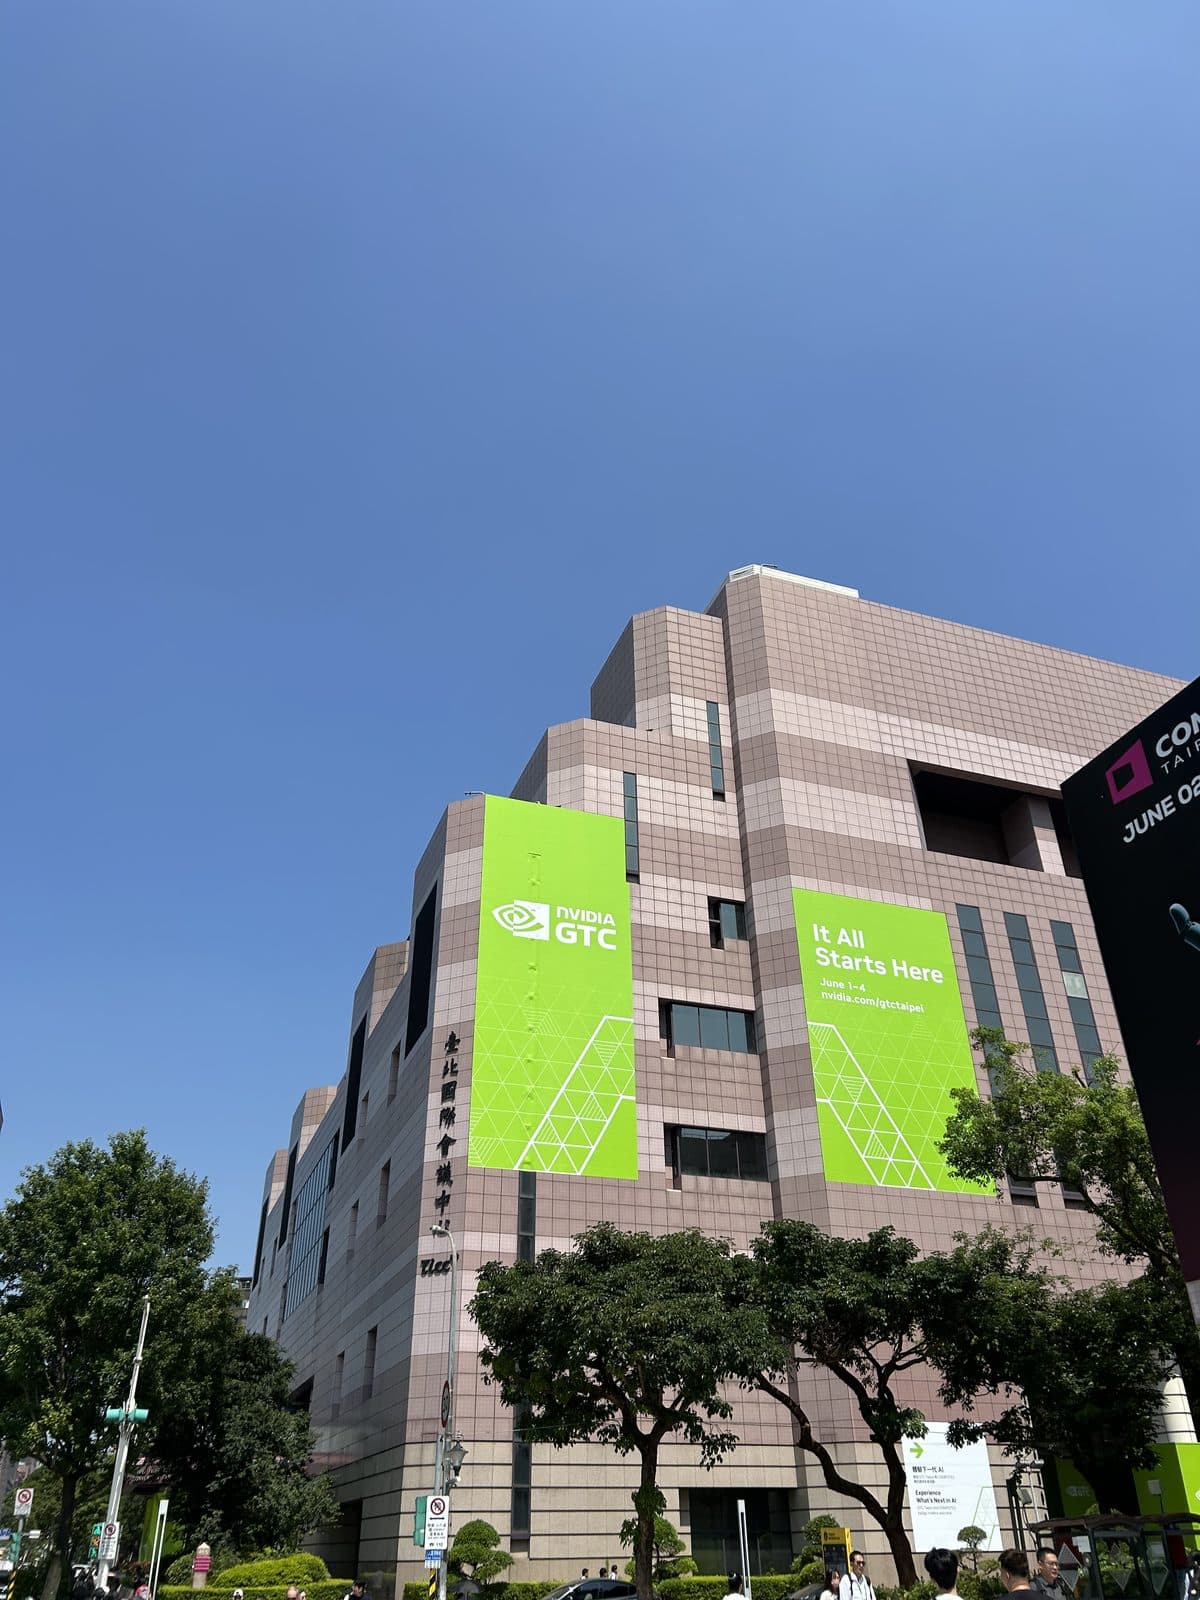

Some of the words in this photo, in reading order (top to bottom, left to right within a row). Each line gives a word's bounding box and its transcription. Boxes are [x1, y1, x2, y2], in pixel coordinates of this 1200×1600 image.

[1123, 795, 1176, 843] JUNE
[555, 922, 617, 951] GTC
[812, 923, 831, 944] It
[837, 928, 865, 949] All
[815, 946, 887, 976] Starts
[891, 958, 944, 984] Here
[820, 977, 845, 990] June
[821, 990, 924, 1013] nvidia.com/gtctaipei
